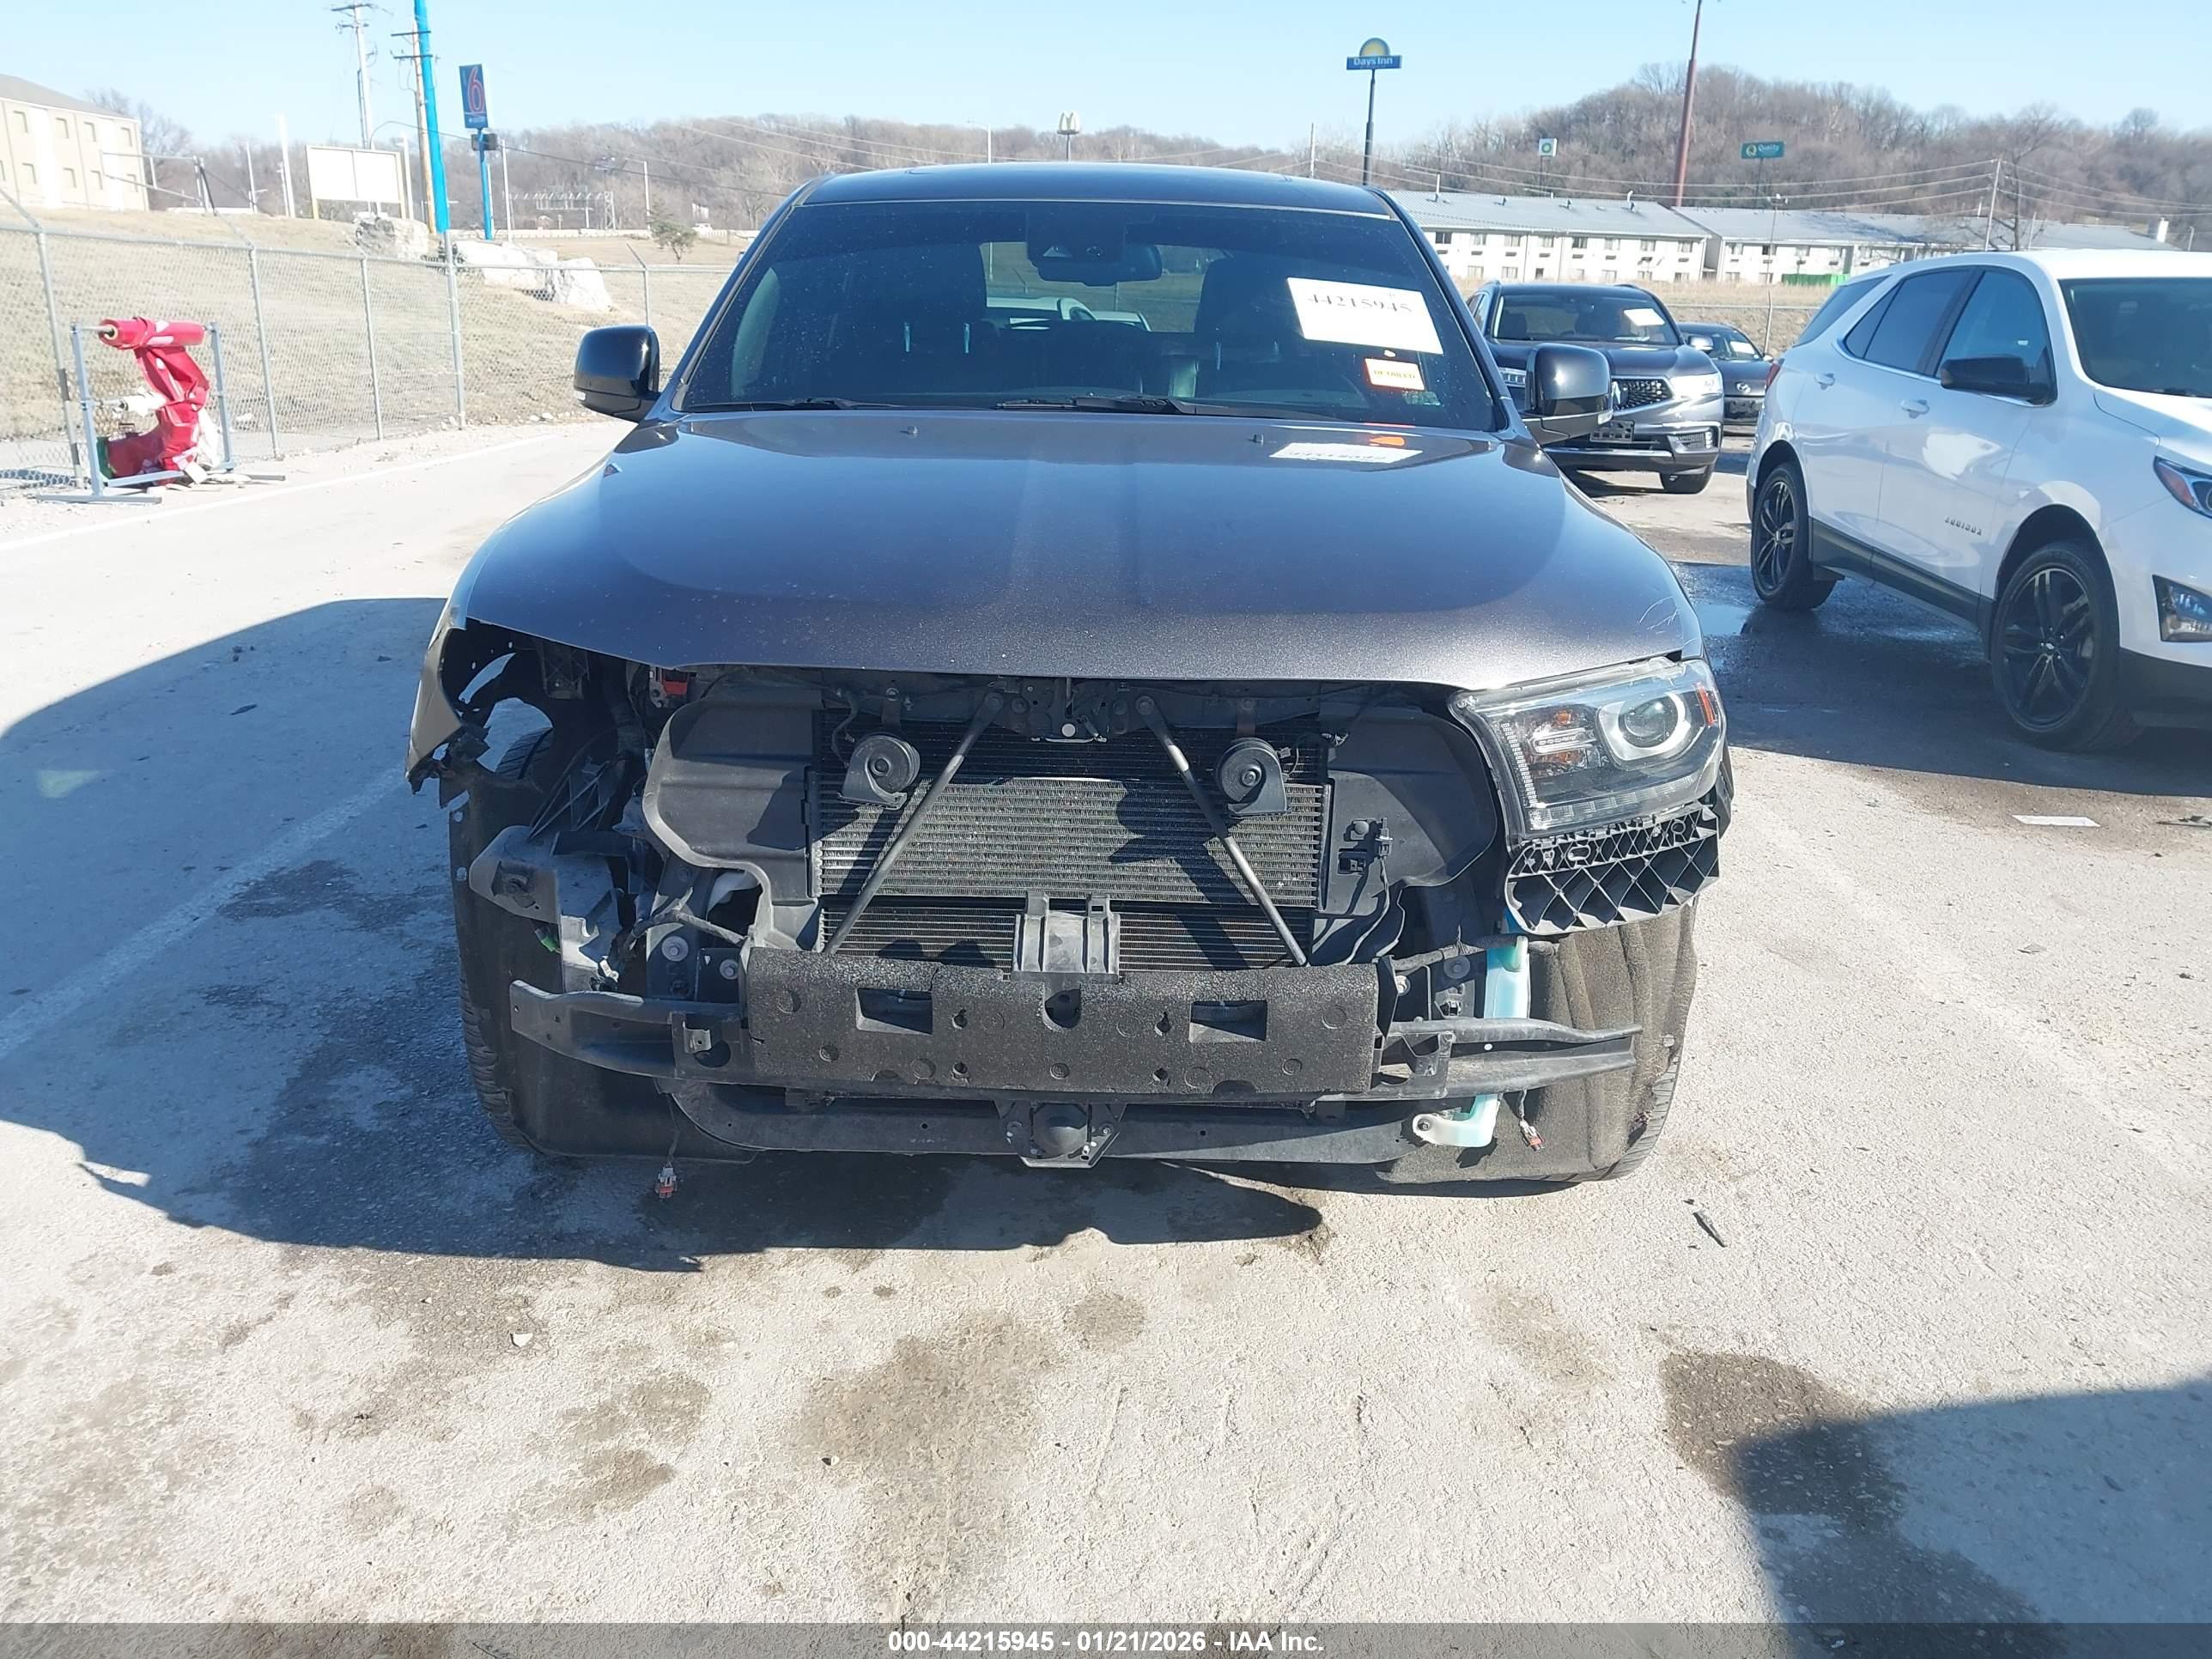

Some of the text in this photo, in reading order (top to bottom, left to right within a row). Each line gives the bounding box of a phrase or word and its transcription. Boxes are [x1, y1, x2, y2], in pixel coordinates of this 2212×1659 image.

[1353, 57, 1393, 66] Days Inn
[467, 67, 485, 115] 6
[1308, 293, 1413, 313] 44215945
